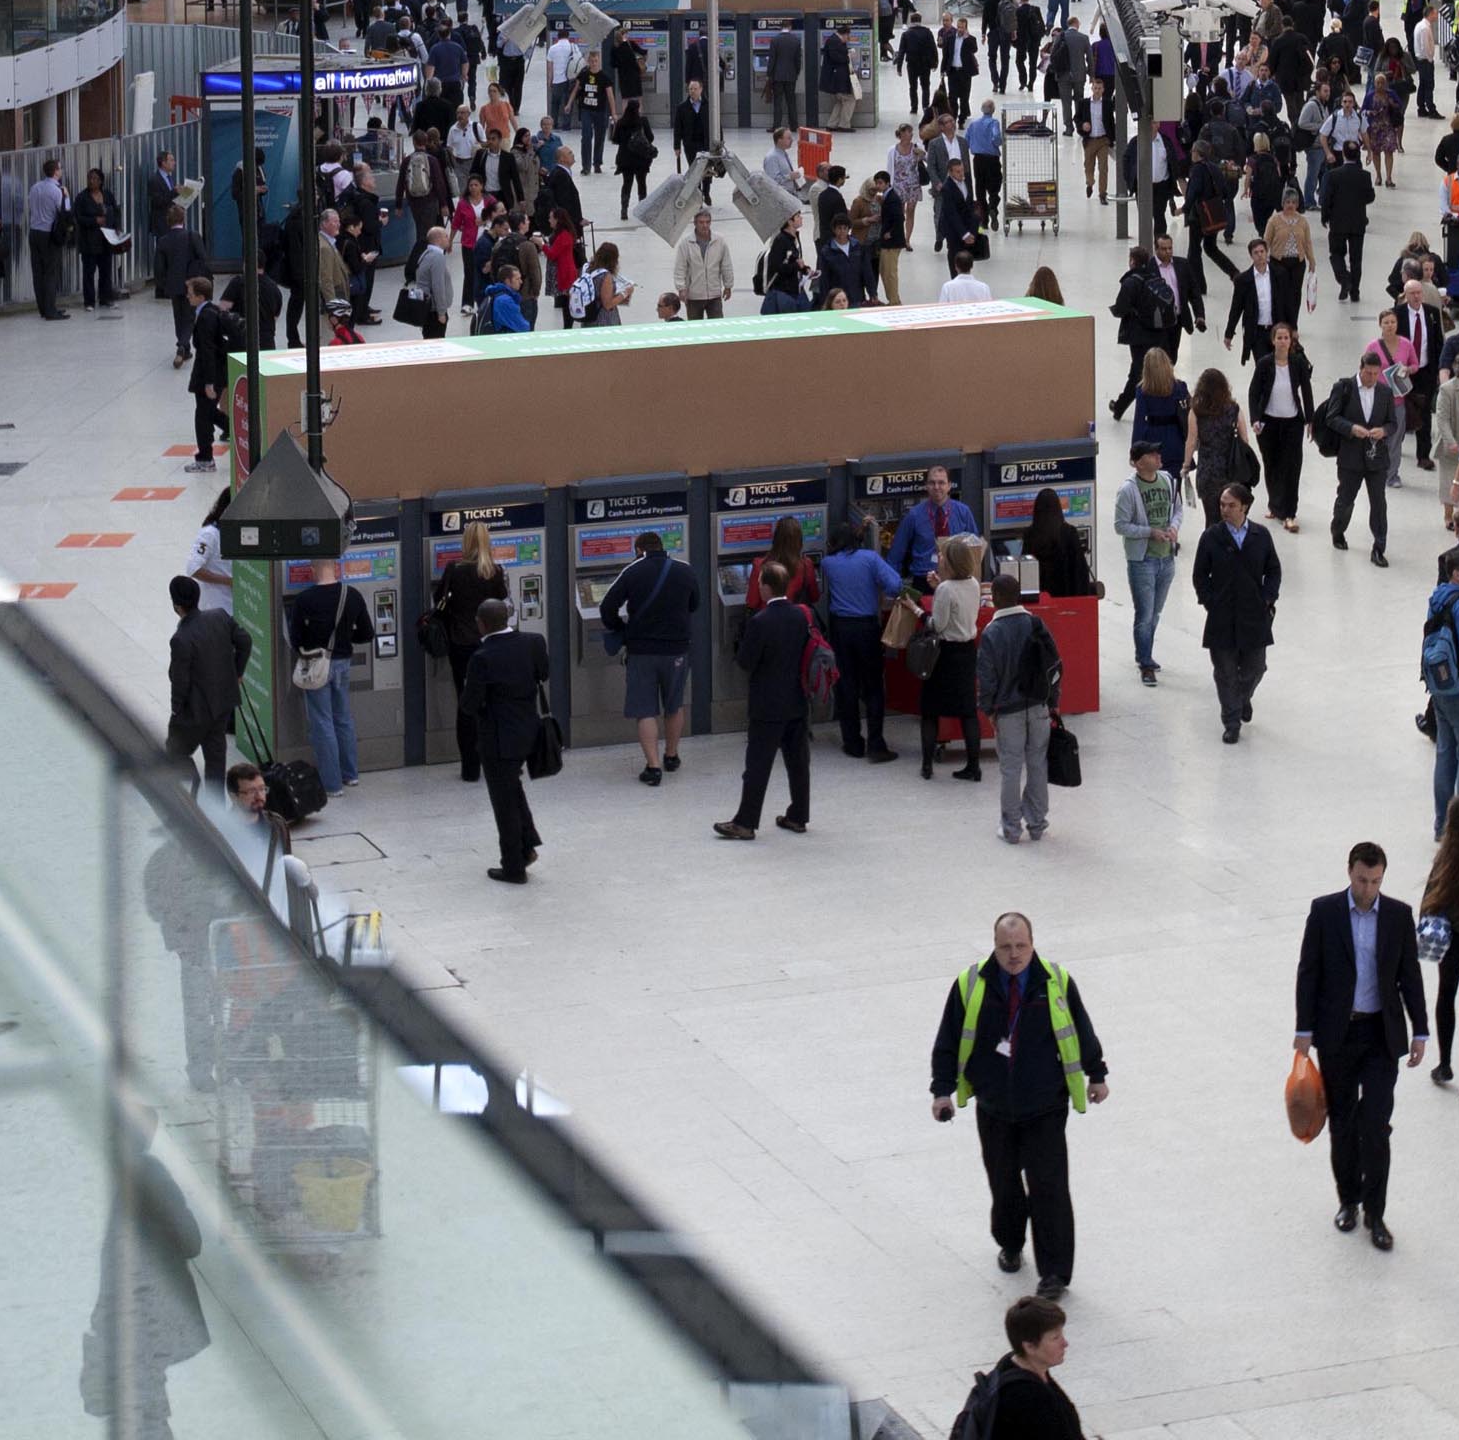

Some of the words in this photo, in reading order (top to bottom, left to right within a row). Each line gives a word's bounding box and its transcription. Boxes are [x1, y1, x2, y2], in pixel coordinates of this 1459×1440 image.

[340, 68, 412, 89] information
[1021, 460, 1058, 472] TICKETS
[887, 472, 924, 484] TICKETS
[1020, 473, 1035, 482] Card
[1035, 472, 1065, 481] Payments
[749, 484, 788, 495] TICKETS
[886, 484, 901, 493] Cash
[901, 483, 914, 492] and
[609, 495, 647, 507] TICKETS
[749, 496, 765, 505] Card
[765, 495, 795, 505] Payments
[463, 508, 504, 520] TICKETS
[608, 508, 622, 517] Cash
[622, 507, 635, 517] and
[635, 506, 651, 516] Card
[652, 504, 683, 516] Payments
[363, 530, 395, 542] Payments
